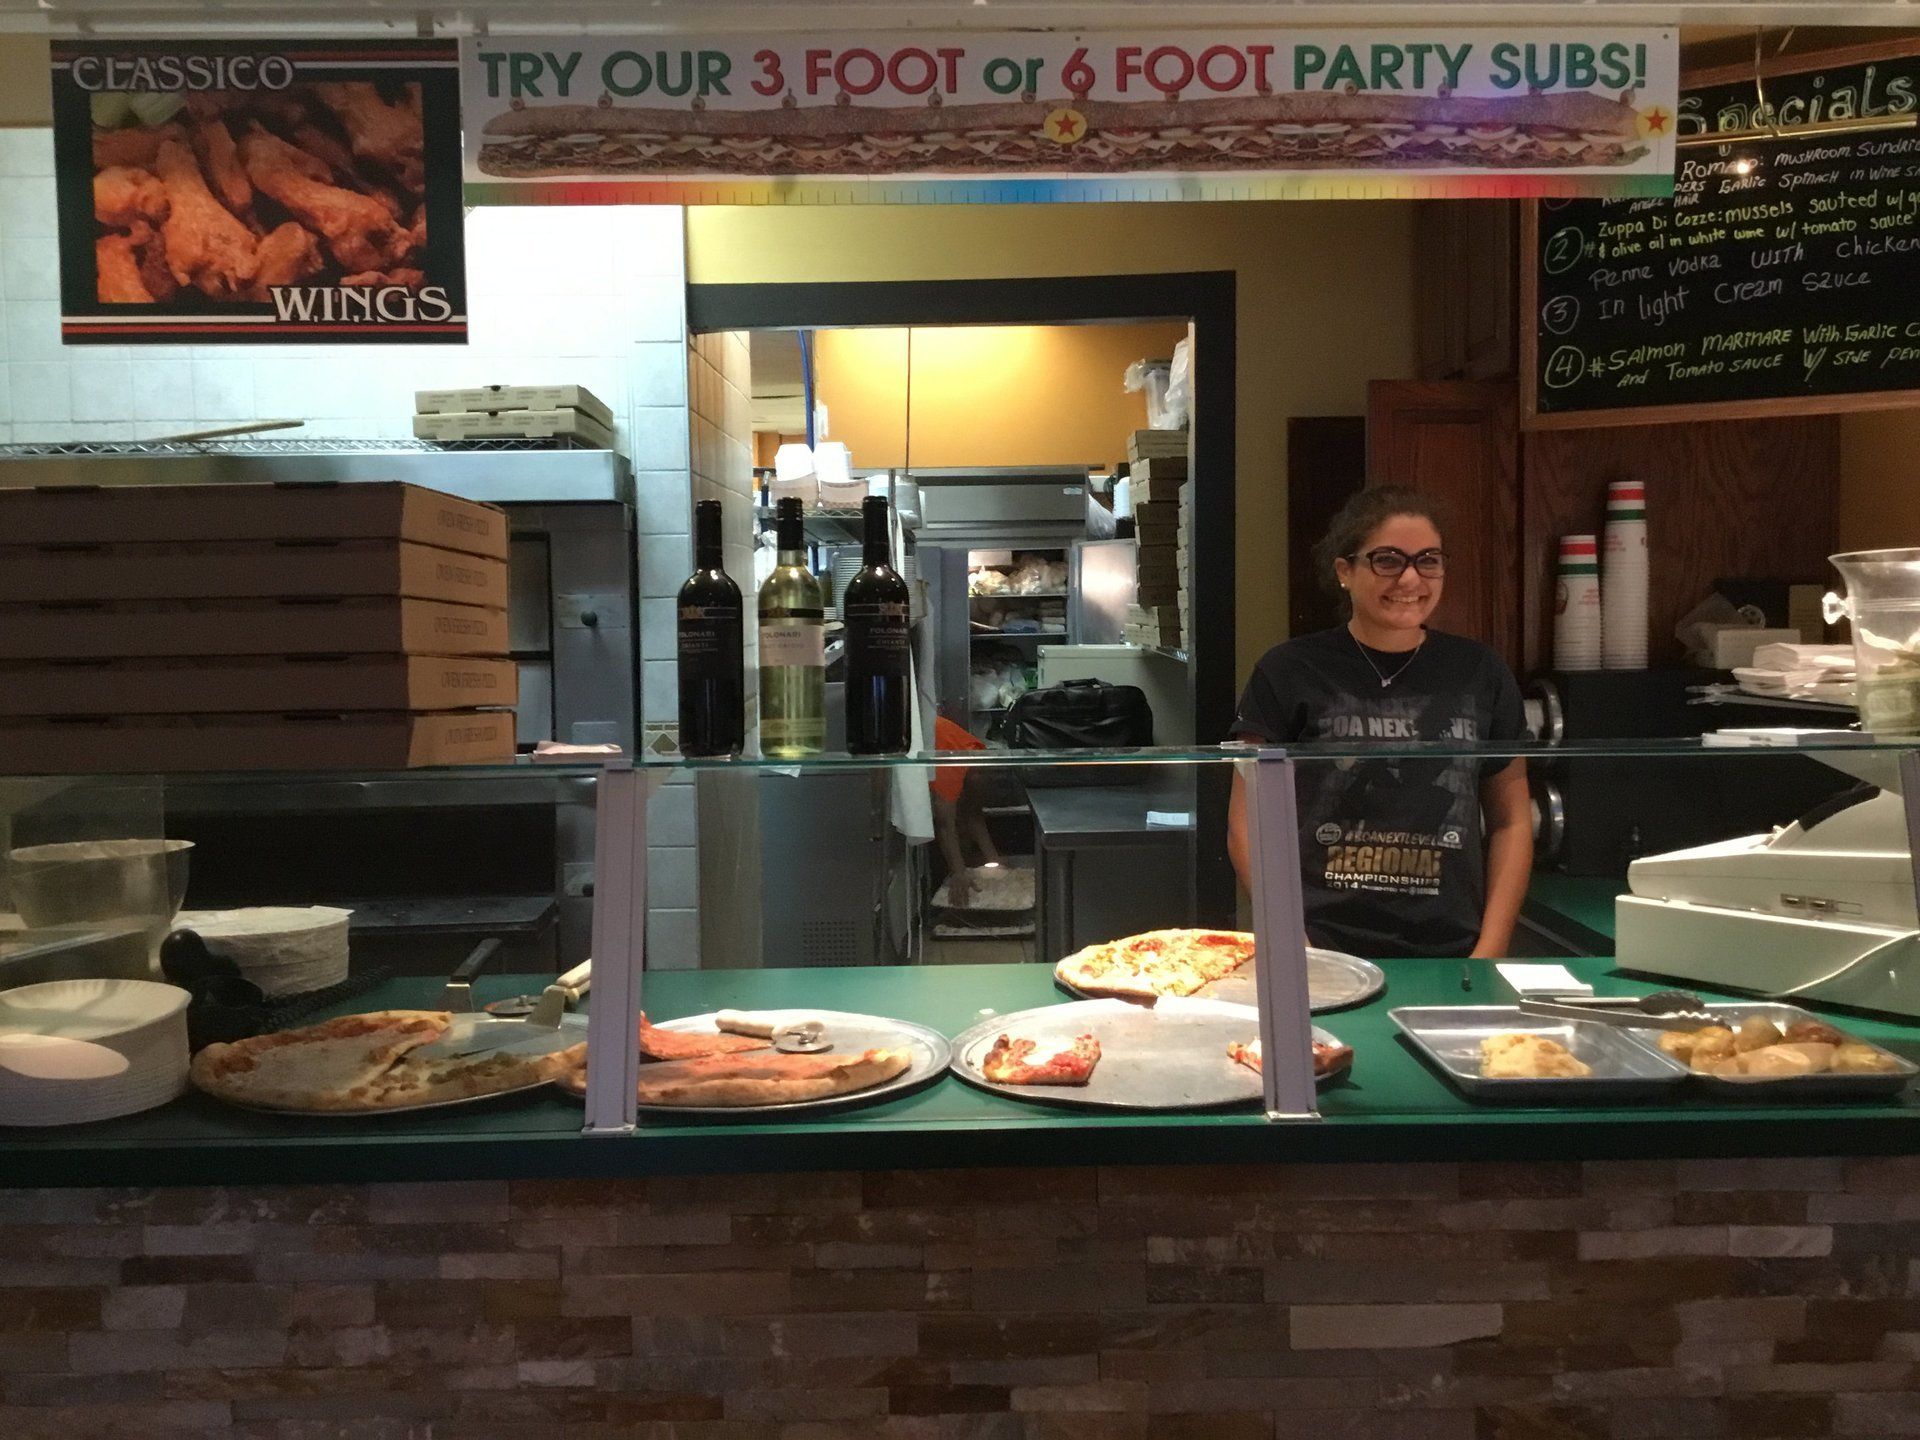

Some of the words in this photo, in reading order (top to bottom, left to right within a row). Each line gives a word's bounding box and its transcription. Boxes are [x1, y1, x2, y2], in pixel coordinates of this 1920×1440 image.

[71, 54, 295, 92] CLASSICO
[479, 50, 583, 97] TRY
[601, 50, 732, 97] OUR
[750, 49, 784, 96] 3
[805, 47, 965, 95] FOOT
[982, 56, 1044, 95] or
[1060, 44, 1096, 92] 6
[1116, 44, 1275, 93] FOOT
[1294, 43, 1473, 92] PARTY
[1489, 41, 1647, 90] SUBS!
[1598, 220, 1644, 240] Zuppa
[1652, 215, 1668, 230] Di
[1808, 189, 1877, 214] sauteed
[1612, 240, 1642, 258] olive
[1650, 234, 1664, 250] oil
[1688, 228, 1726, 245] white
[1801, 217, 1857, 235] tomato
[1870, 213, 1913, 229] sauce
[1588, 265, 1653, 291] Penne
[1598, 299, 1625, 320] In
[1639, 286, 1690, 326] light
[1714, 278, 1783, 303] Cream
[1802, 271, 1871, 291] Sauce
[269, 285, 454, 323] WINGS
[1324, 871, 1441, 886] CHAMPIONSHIPS
